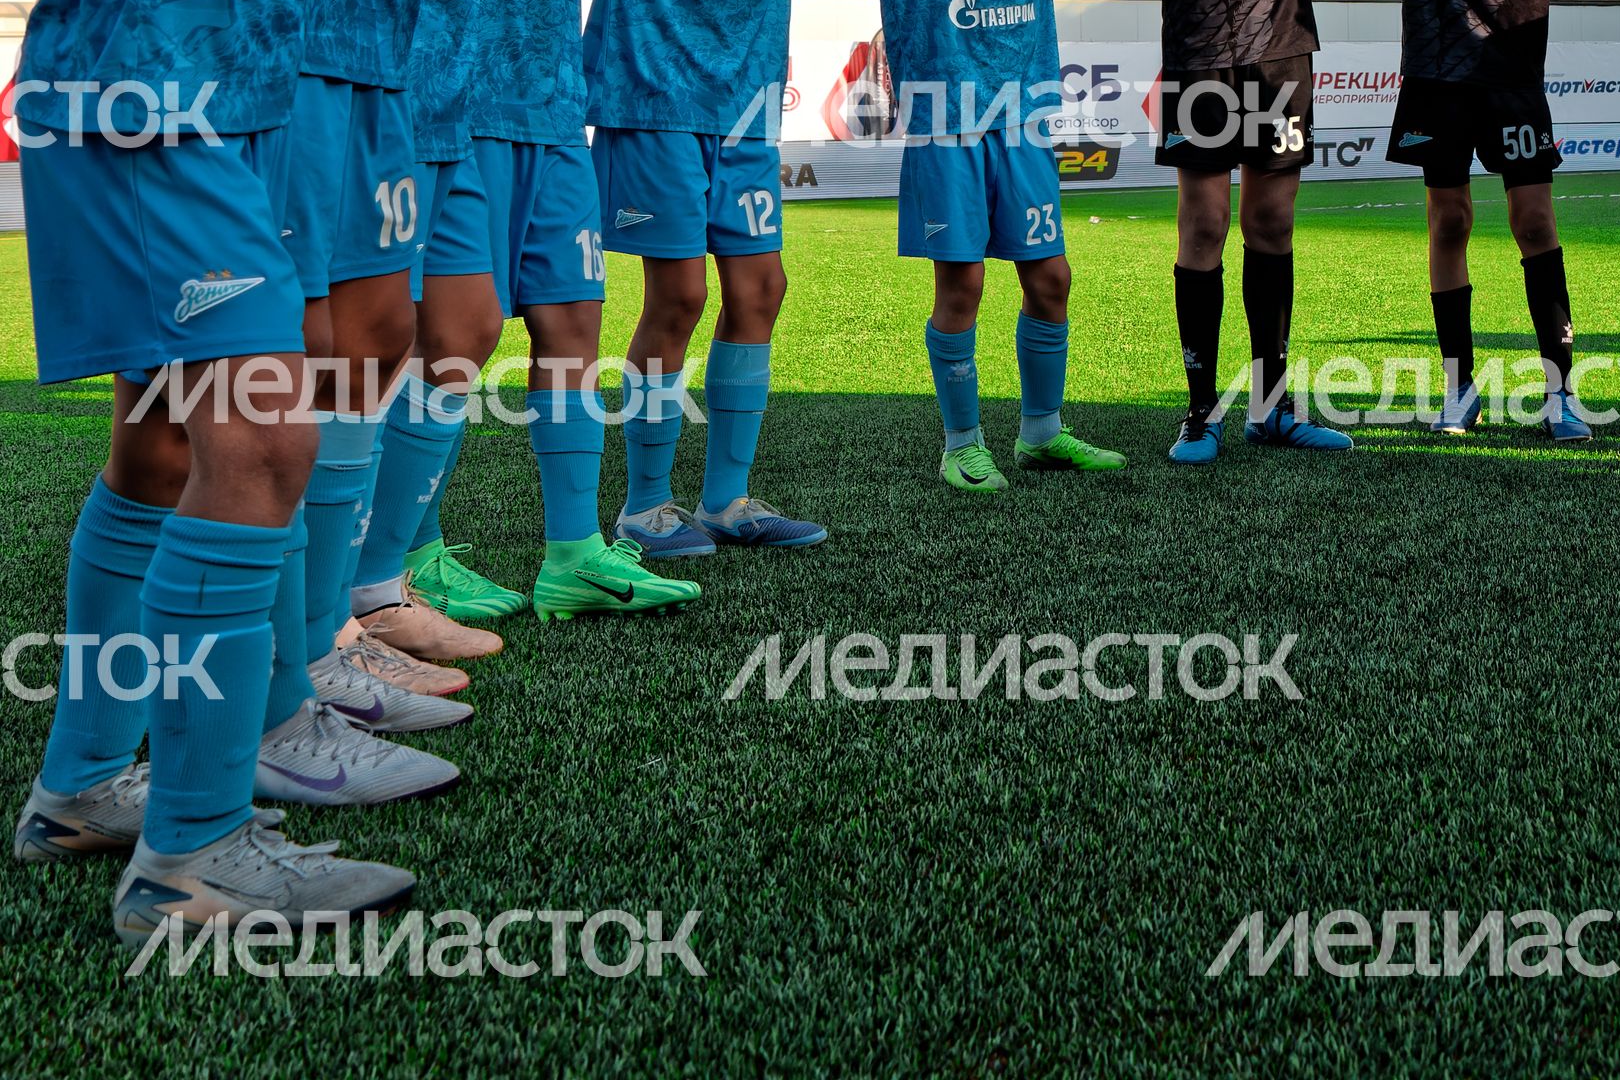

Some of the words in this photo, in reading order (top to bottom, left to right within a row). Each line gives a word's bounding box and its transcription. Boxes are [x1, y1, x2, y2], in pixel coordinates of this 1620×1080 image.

[981, 2, 1036, 28] ГАЗПРОМ
[1054, 118, 1119, 130] спонсор
[1271, 116, 1305, 154] 35
[1502, 124, 1537, 161] 50
[1057, 150, 1109, 174] 24
[375, 176, 417, 249] 10
[738, 190, 778, 238] 12
[1026, 203, 1057, 246] 23
[575, 229, 605, 282] 16
